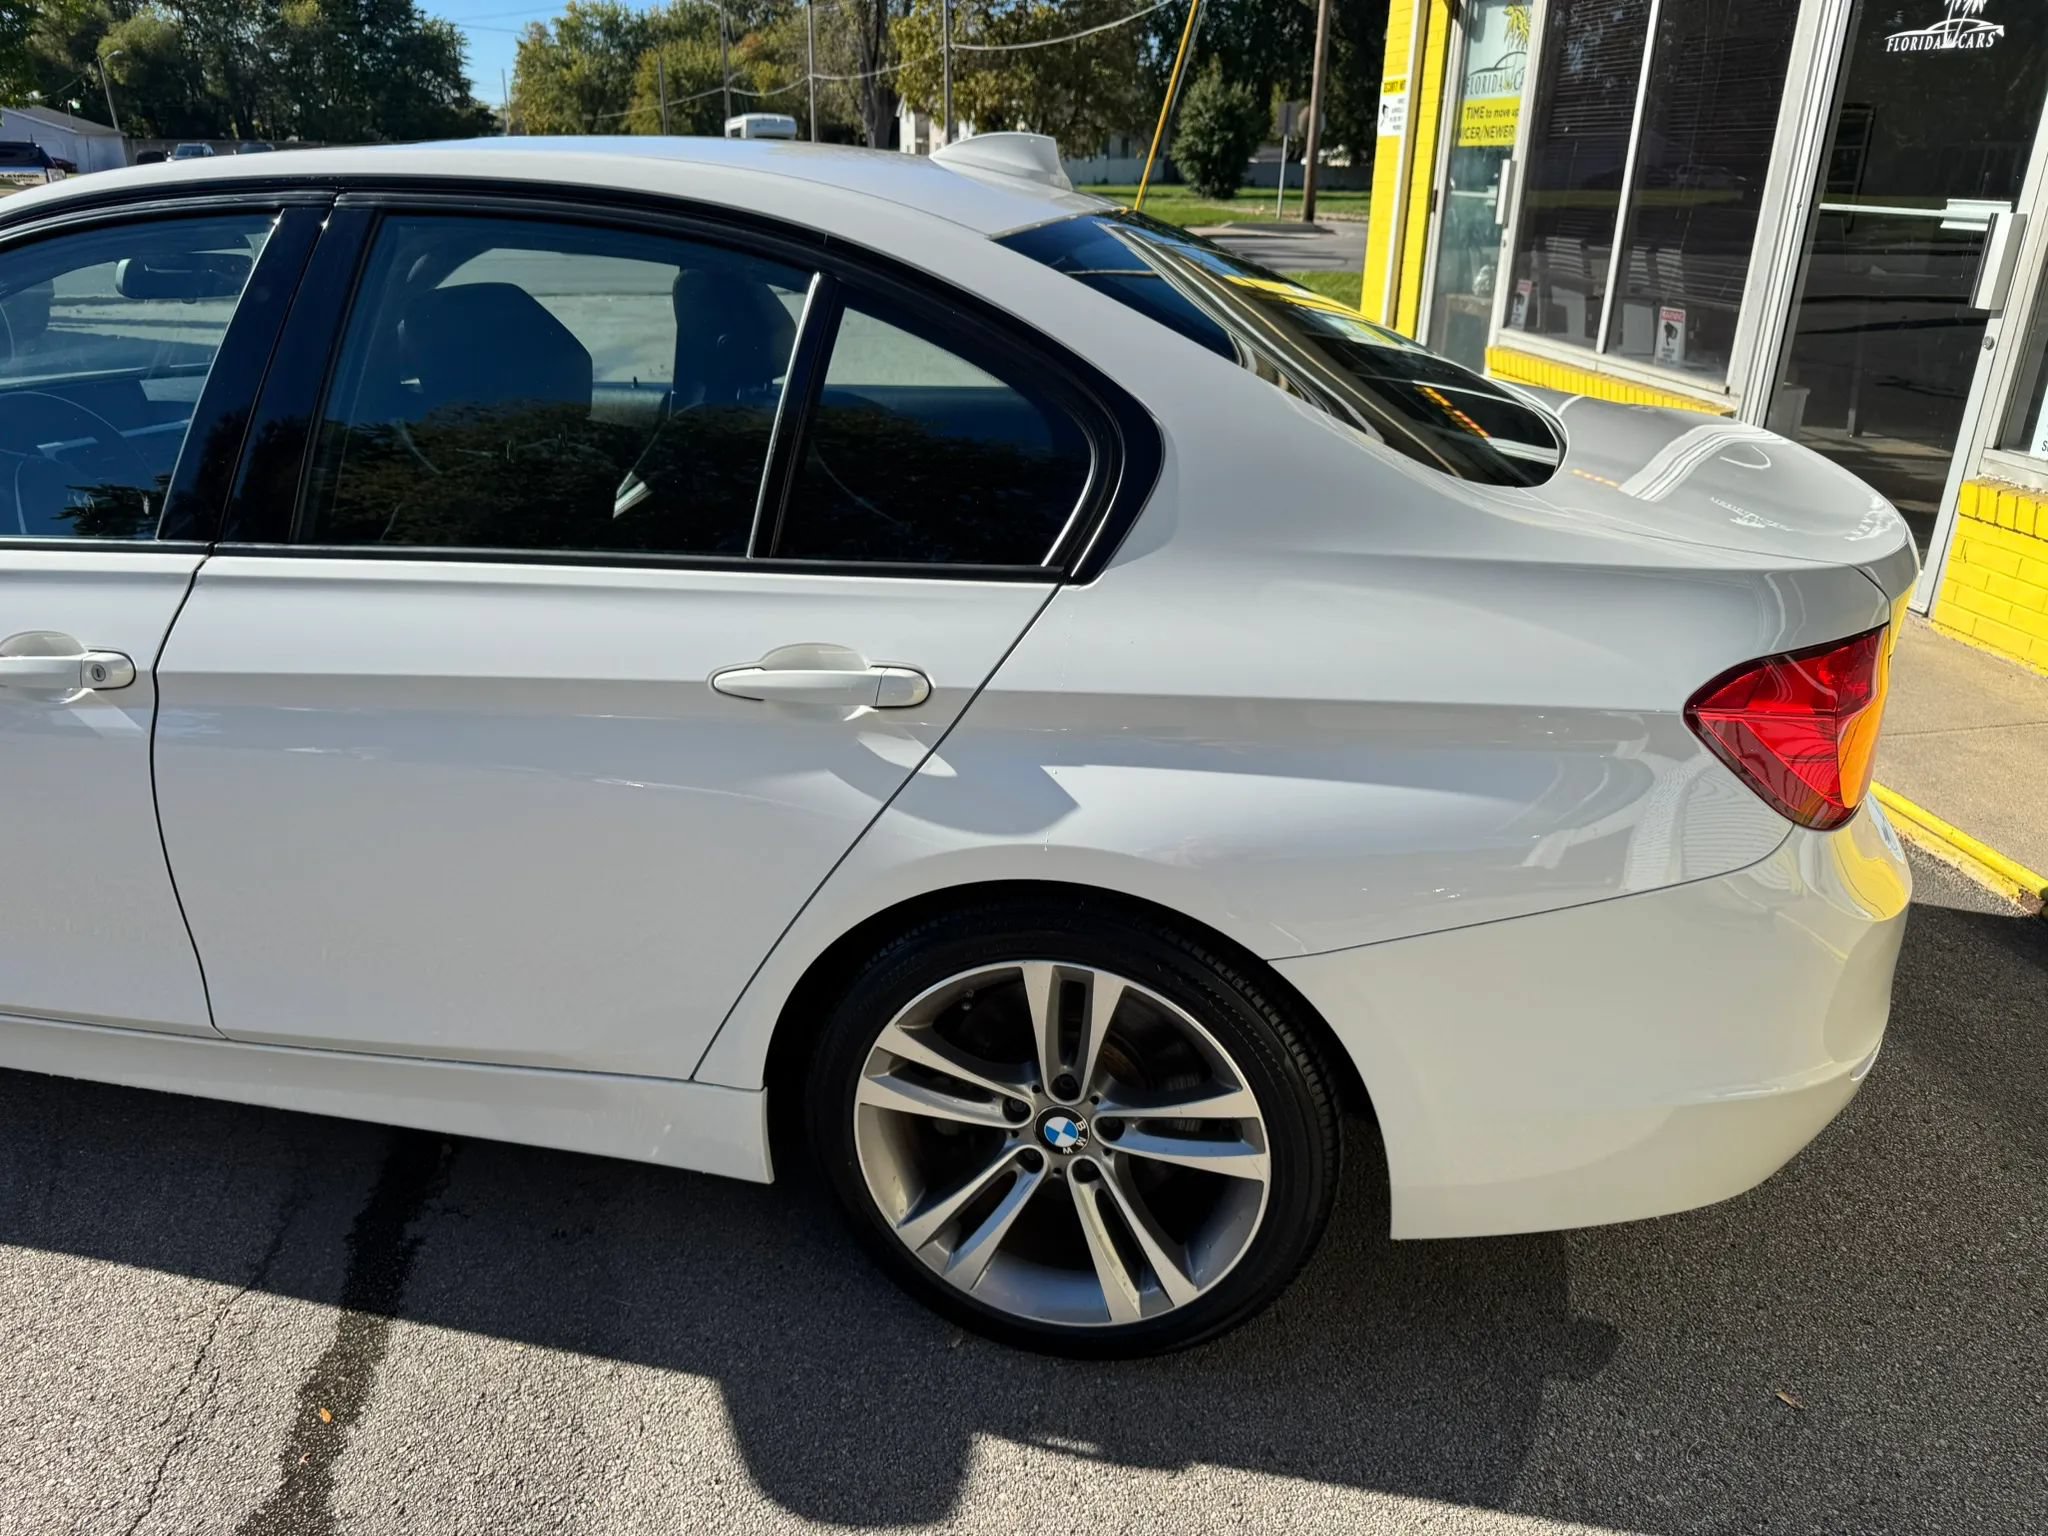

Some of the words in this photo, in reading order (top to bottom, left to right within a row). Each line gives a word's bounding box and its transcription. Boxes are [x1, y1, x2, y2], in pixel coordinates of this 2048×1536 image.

[1886, 35, 1941, 52] FLORIDA
[1958, 31, 1996, 48] CARS
[1466, 106, 1485, 120] TIME
[1494, 108, 1510, 118] move
[1061, 1121, 1087, 1155] BMW
